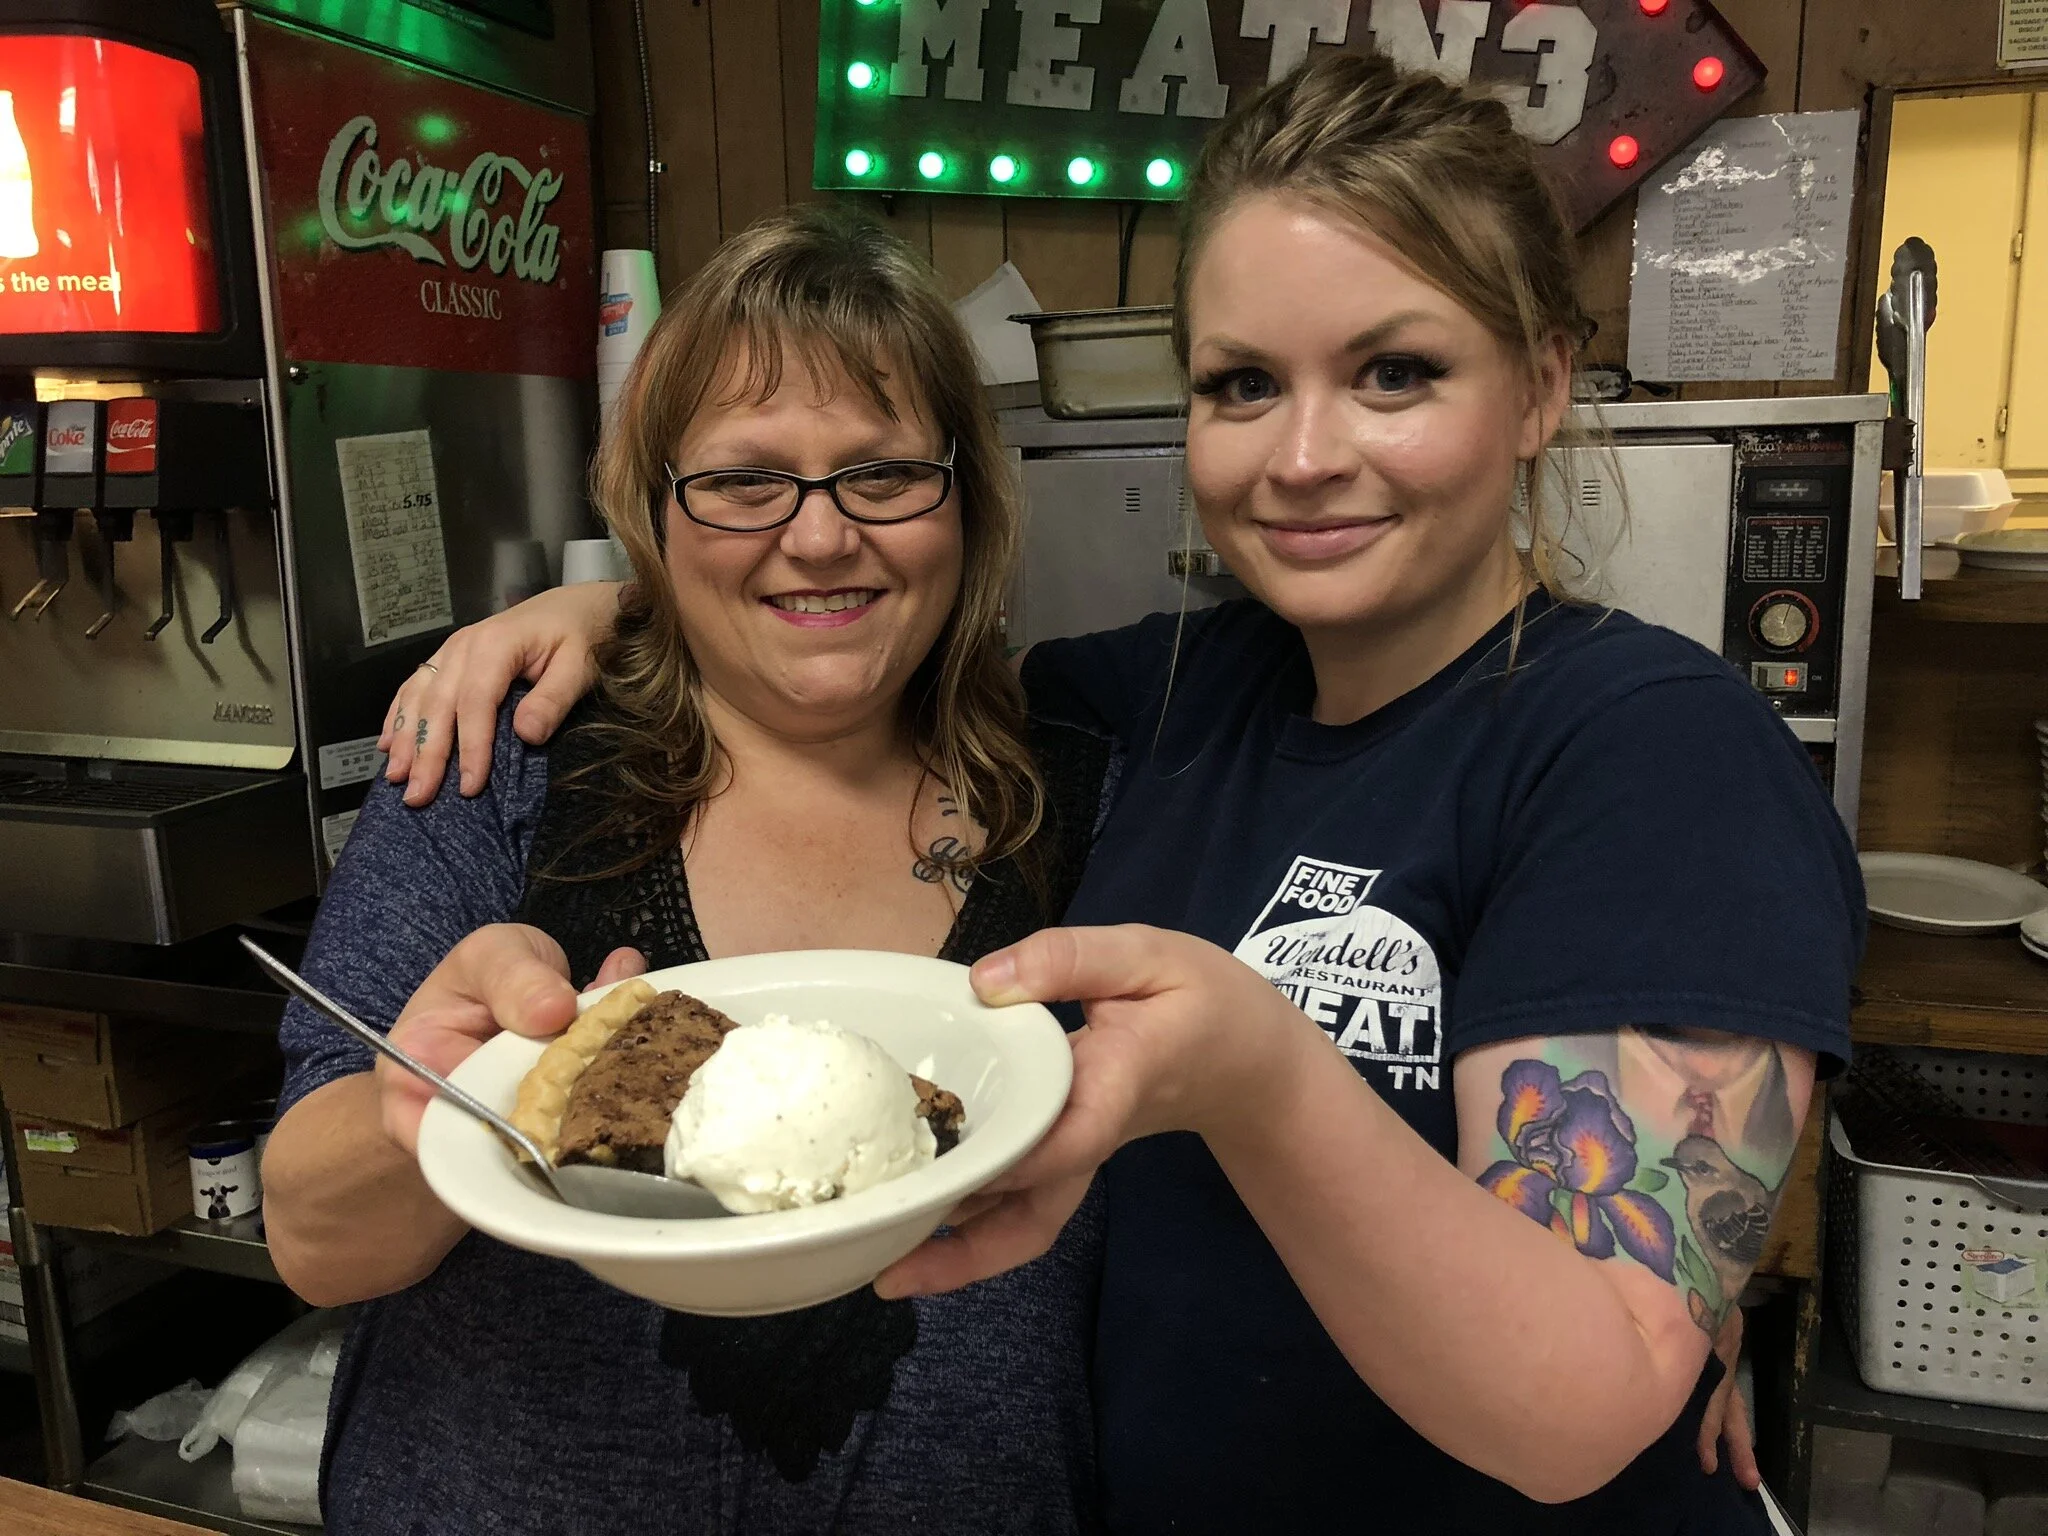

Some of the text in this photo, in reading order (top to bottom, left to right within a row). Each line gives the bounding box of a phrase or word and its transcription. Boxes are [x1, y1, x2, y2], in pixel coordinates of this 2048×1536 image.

[11, 271, 51, 293] the
[420, 279, 502, 320] CLASSIC
[49, 427, 86, 447] Coke
[403, 494, 432, 509] 5.75
[213, 701, 273, 724] LANCER
[1293, 865, 1360, 896] FINE
[1280, 885, 1358, 915] FOOD
[1291, 967, 1430, 998] RESTAURANT
[1276, 984, 1429, 1056] EAT
[1387, 1065, 1440, 1090] TN
